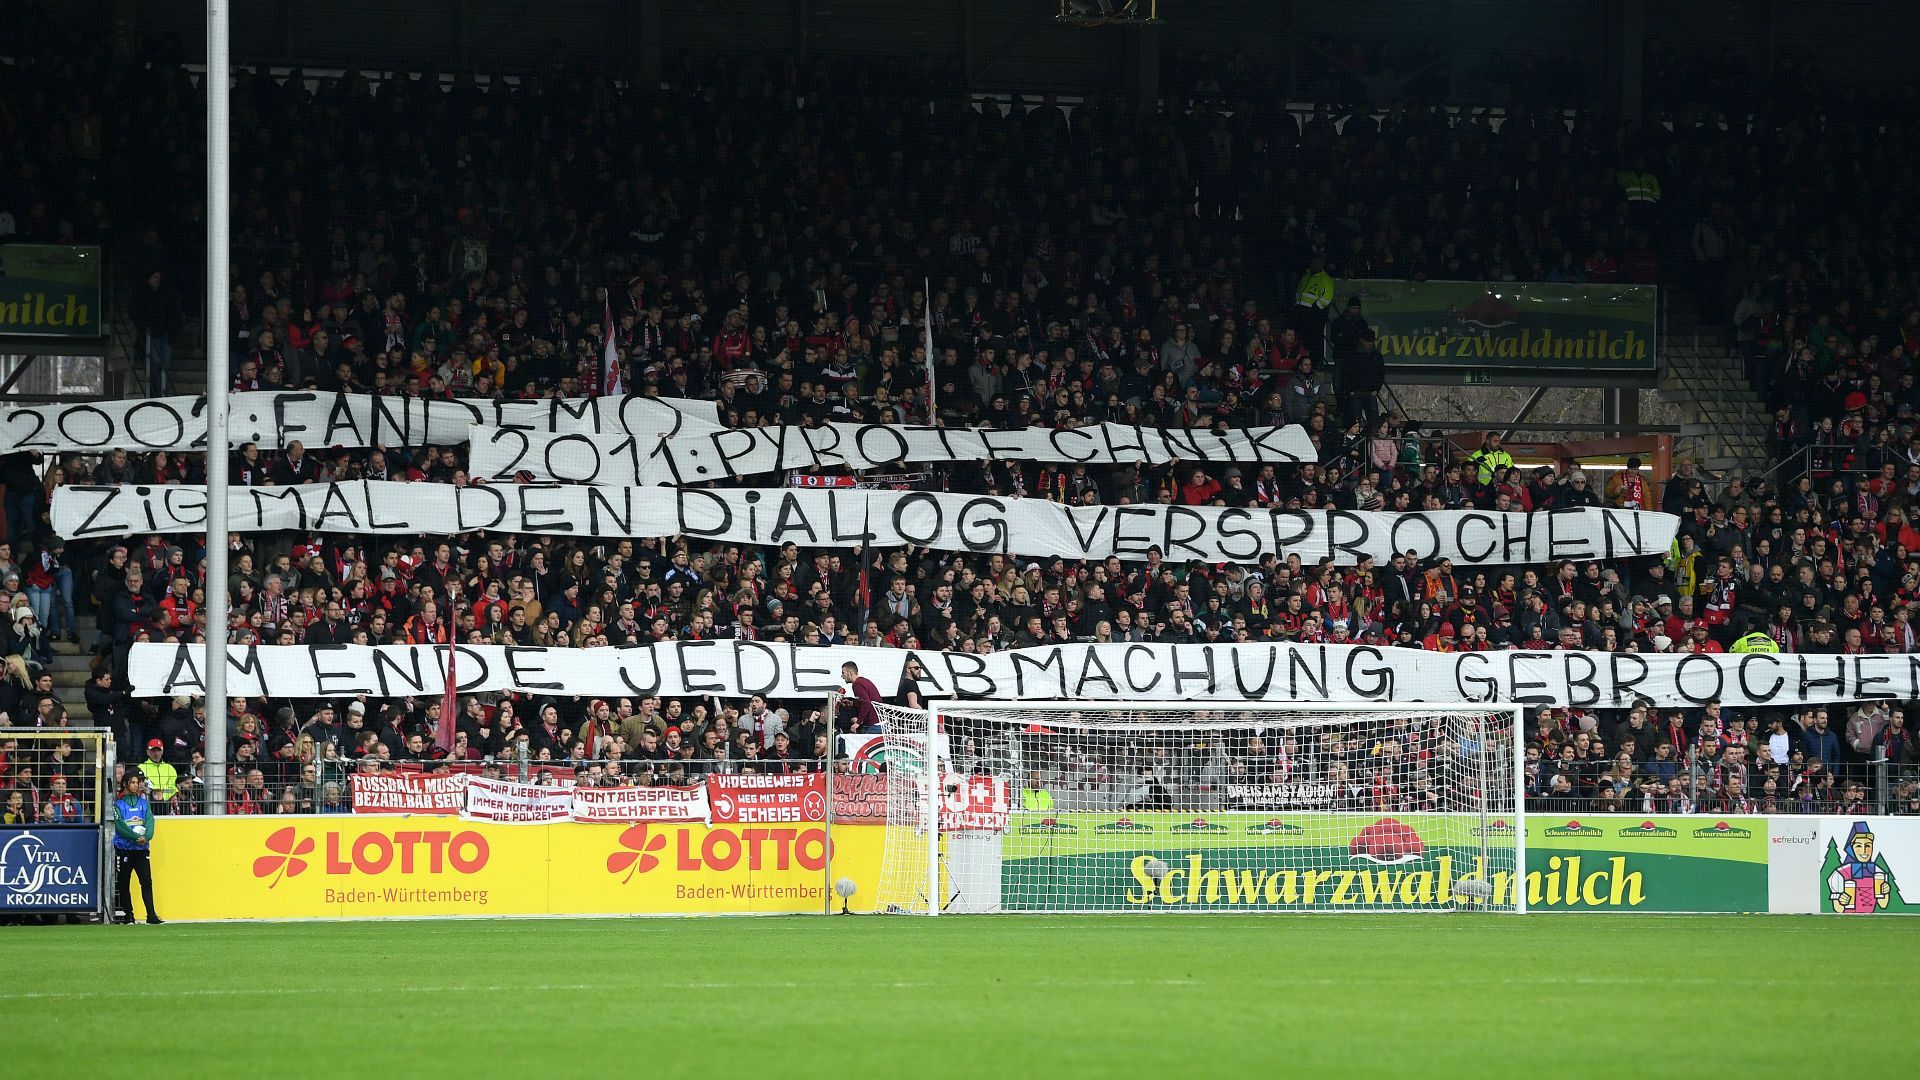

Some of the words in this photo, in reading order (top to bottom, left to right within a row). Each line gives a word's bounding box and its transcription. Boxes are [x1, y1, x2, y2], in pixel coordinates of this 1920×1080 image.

[1368, 325, 1647, 360] hwarzwaldmilch
[249, 480, 409, 529] MAL
[455, 485, 631, 535] DEN
[1064, 507, 1643, 563] VERSPROCHEN
[164, 643, 270, 696] AM
[308, 643, 565, 696] ENDE
[614, 640, 845, 694] JEDE
[902, 643, 1394, 702] ABMACHUNG
[1455, 648, 1920, 706] GEBROCHE
[353, 777, 421, 792] FUSSBALL
[424, 777, 464, 793] MUSS
[718, 775, 803, 788] VIDEOBEWEIS
[490, 784, 509, 795] WIR
[511, 786, 547, 798] LIEBEN
[573, 790, 700, 803] MONTAGSSPIELE
[355, 792, 433, 807] BEZAHLBAR
[473, 797, 504, 810] IMMER
[737, 794, 757, 804] WEG
[760, 794, 776, 804] MIT
[779, 794, 798, 803] DEM
[493, 812, 509, 822] DIE
[511, 812, 551, 822] POLIZEI
[587, 805, 689, 817] ABSCHAFFEN
[738, 807, 801, 822] SCHEISS
[1694, 830, 1750, 838] Schwarzwaldmilch
[326, 831, 490, 875] LOTTO
[677, 828, 834, 871] LOTTO
[1127, 853, 1646, 906] Schwarzwaldmilch
[7, 893, 89, 905] KROZINGEN
[325, 887, 489, 905] Baden-Württemberg
